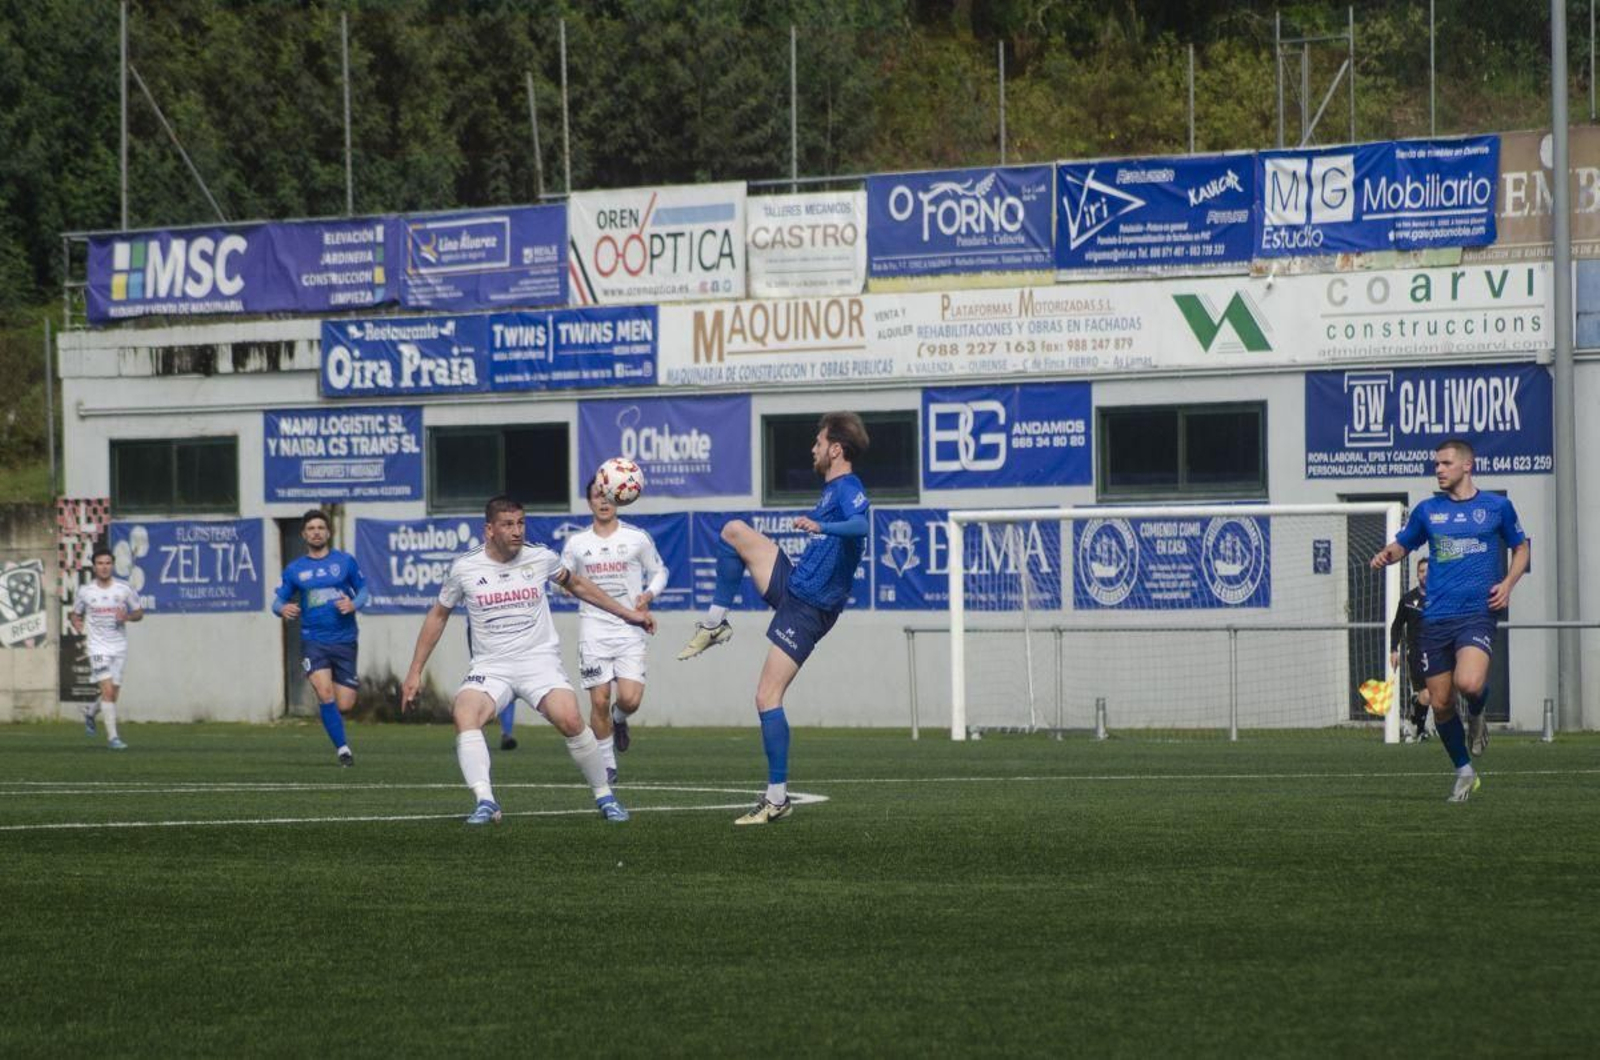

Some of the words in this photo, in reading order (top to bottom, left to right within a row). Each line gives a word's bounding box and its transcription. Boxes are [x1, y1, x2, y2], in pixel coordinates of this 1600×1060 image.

[1362, 171, 1491, 212] Mobiliario
[596, 208, 640, 230] OREN
[763, 204, 802, 217] TALLERES
[889, 185, 914, 222] O
[917, 186, 1025, 242] FORNO
[751, 222, 858, 250] CASTRO
[1261, 226, 1324, 250] Estudio
[146, 234, 248, 299] MSC
[330, 290, 374, 305] LIMPIEZA
[603, 282, 689, 298] www.orenoptica.es
[1326, 267, 1534, 307] coarvi
[874, 309, 899, 322] VENTA
[940, 293, 1014, 321] PLATAFORMAS
[492, 323, 547, 349] TWINS
[558, 321, 614, 346] TWINS
[616, 320, 653, 342] MEN
[692, 298, 866, 364] MAQUINOR
[877, 324, 914, 341] ALQUILER
[916, 321, 1013, 340] REHABILITACIONES
[1016, 322, 1024, 334] Y
[1028, 319, 1063, 335] OBRAS
[1067, 319, 1081, 333] EN
[1084, 316, 1142, 332] FACHADAS
[1326, 313, 1542, 340] construccions
[966, 341, 997, 356] 227
[1005, 340, 1036, 354] 163
[1066, 338, 1088, 352] 988
[327, 344, 394, 390] Oira
[397, 343, 478, 388] Praia
[666, 366, 724, 385] MAQUINARIA
[725, 368, 737, 383] DE
[738, 362, 807, 382] CONSTRUCCION
[809, 363, 816, 377] Y
[819, 361, 850, 378] OBRAS
[852, 358, 894, 376] PUBLICAS
[1352, 384, 1386, 432] GW
[279, 416, 319, 437] NAMI
[319, 414, 386, 435] LOGISTIC
[387, 414, 408, 434] SL
[929, 400, 1007, 473] BG
[1012, 420, 1085, 435] ANDAMIOS
[267, 438, 278, 457] Y
[279, 438, 326, 457] NAIRA
[328, 437, 349, 456] CS
[349, 435, 399, 456] TRANS
[400, 434, 421, 454] SL
[639, 422, 712, 463] Chicote
[1308, 453, 1329, 463] ROPA
[1329, 452, 1367, 463] LABORAL,
[1368, 452, 1386, 462] EPIS
[1392, 450, 1429, 462] CALZADO
[1492, 456, 1511, 470] 644
[1513, 456, 1532, 470] 623
[1533, 455, 1553, 470] 259
[1308, 463, 1376, 476] PERSONALIZACIÓN
[1378, 463, 1388, 475] DE
[1388, 462, 1425, 475] PRENDAS
[585, 561, 629, 574] TUBANOR
[476, 587, 540, 607] TUBANOR
[11, 617, 42, 639] RFGF
